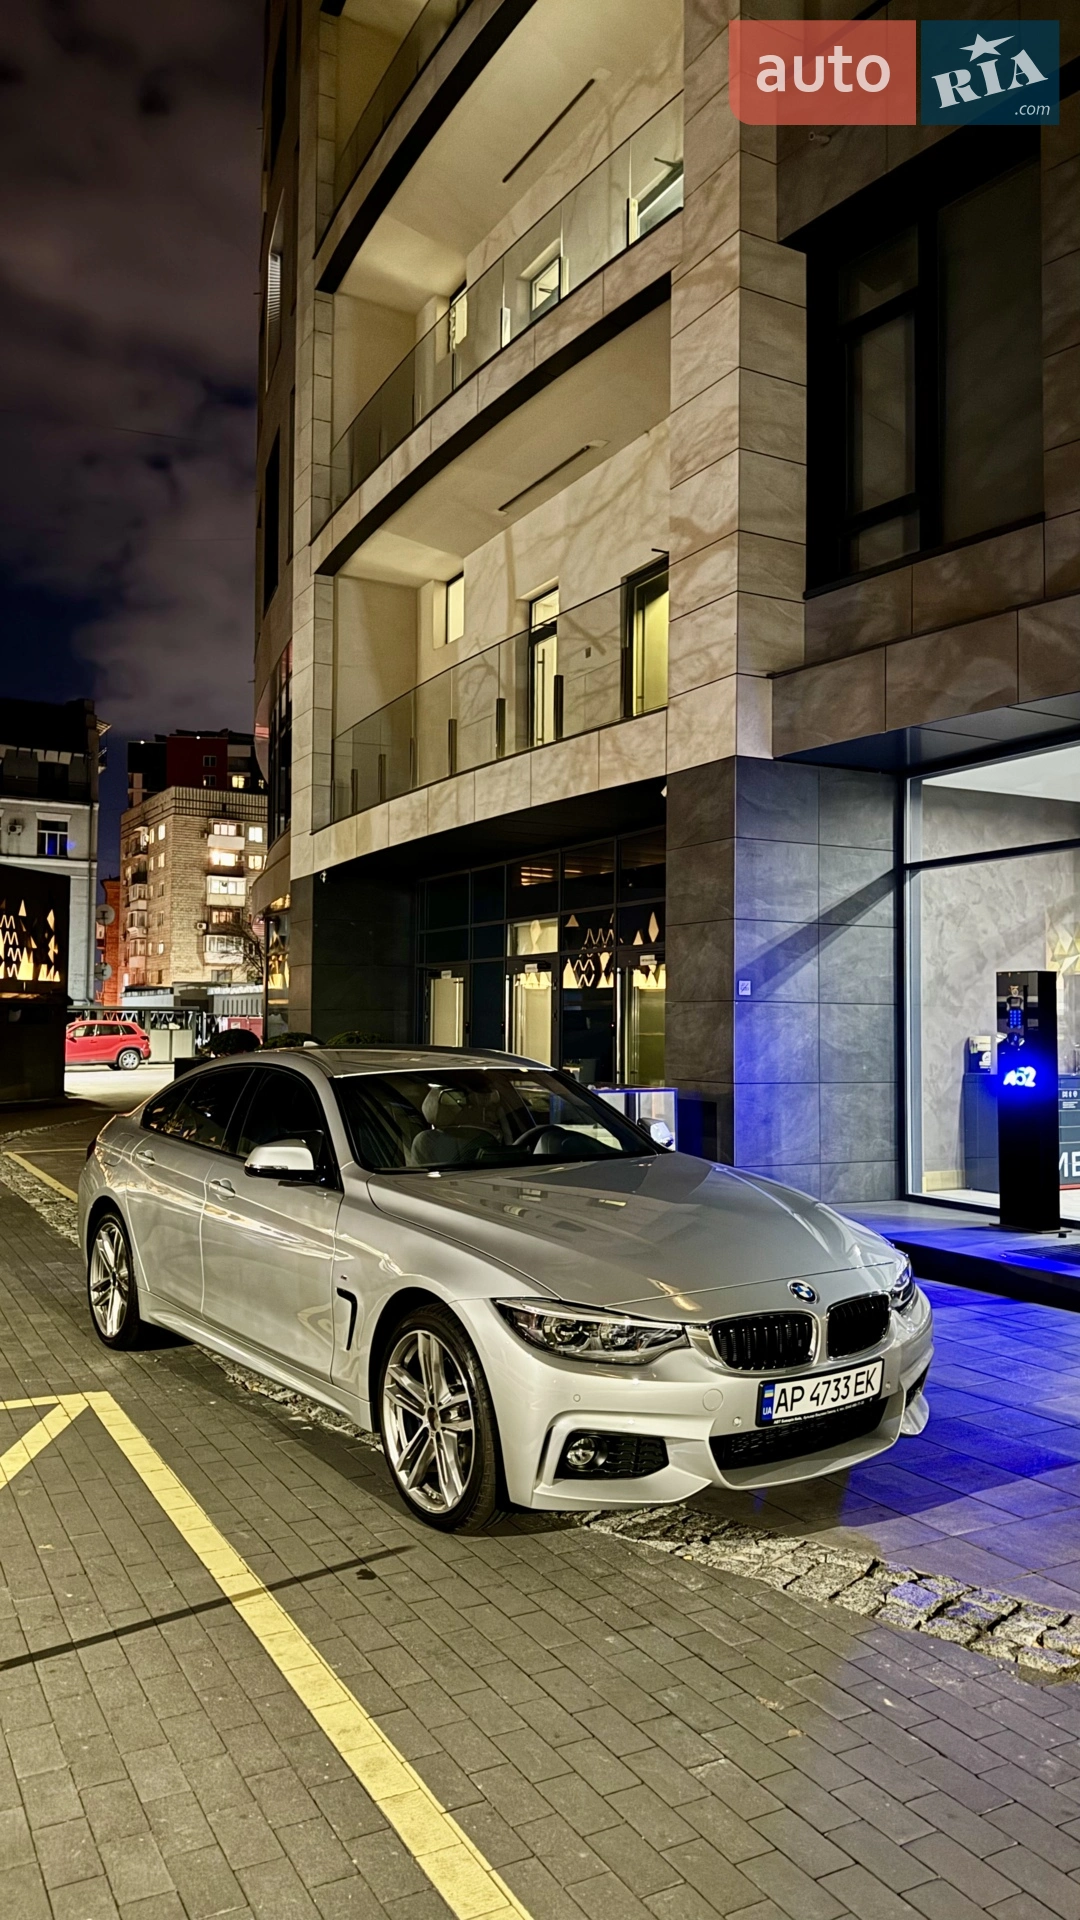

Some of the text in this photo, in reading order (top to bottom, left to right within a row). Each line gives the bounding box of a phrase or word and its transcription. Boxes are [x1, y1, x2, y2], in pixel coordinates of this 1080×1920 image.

[775, 1386, 805, 1414] AP
[810, 1375, 851, 1406] 4733
[854, 1368, 877, 1396] EK
[762, 1406, 772, 1416] UA
